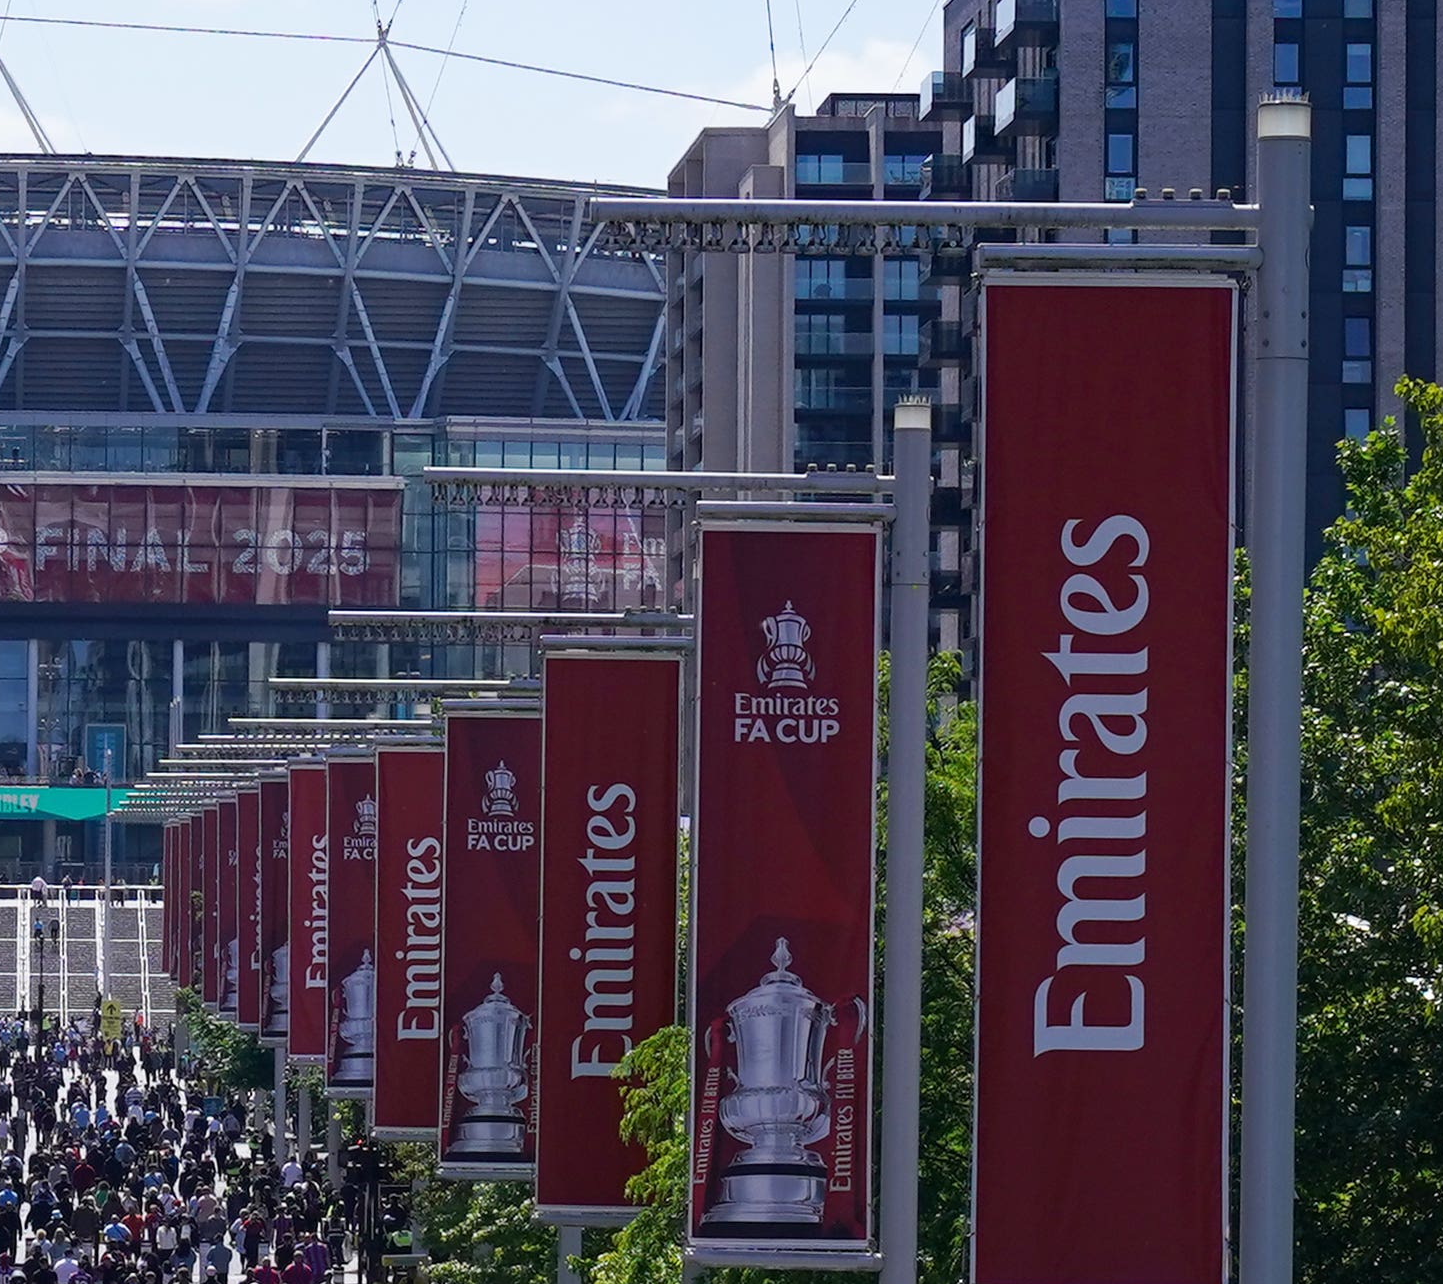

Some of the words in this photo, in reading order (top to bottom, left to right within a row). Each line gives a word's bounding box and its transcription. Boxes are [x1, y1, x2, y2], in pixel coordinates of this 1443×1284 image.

[34, 526, 209, 574] FINAL
[230, 527, 370, 576] 2025
[734, 691, 840, 717] Emirates
[734, 720, 772, 744] FA
[776, 719, 840, 744] CUP
[1028, 514, 1150, 1058] Emirates
[467, 818, 535, 835] Emirates
[467, 836, 490, 851] FA
[494, 835, 536, 852] CUP
[343, 849, 361, 860] FA
[304, 834, 327, 990] Emirates
[569, 782, 636, 1080] Emirates
[396, 837, 441, 1041] Emirates
[837, 1048, 855, 1081] BETTER
[835, 1082, 855, 1100] FLY
[693, 1118, 713, 1184] Emirates
[829, 1105, 855, 1193] Emirates
